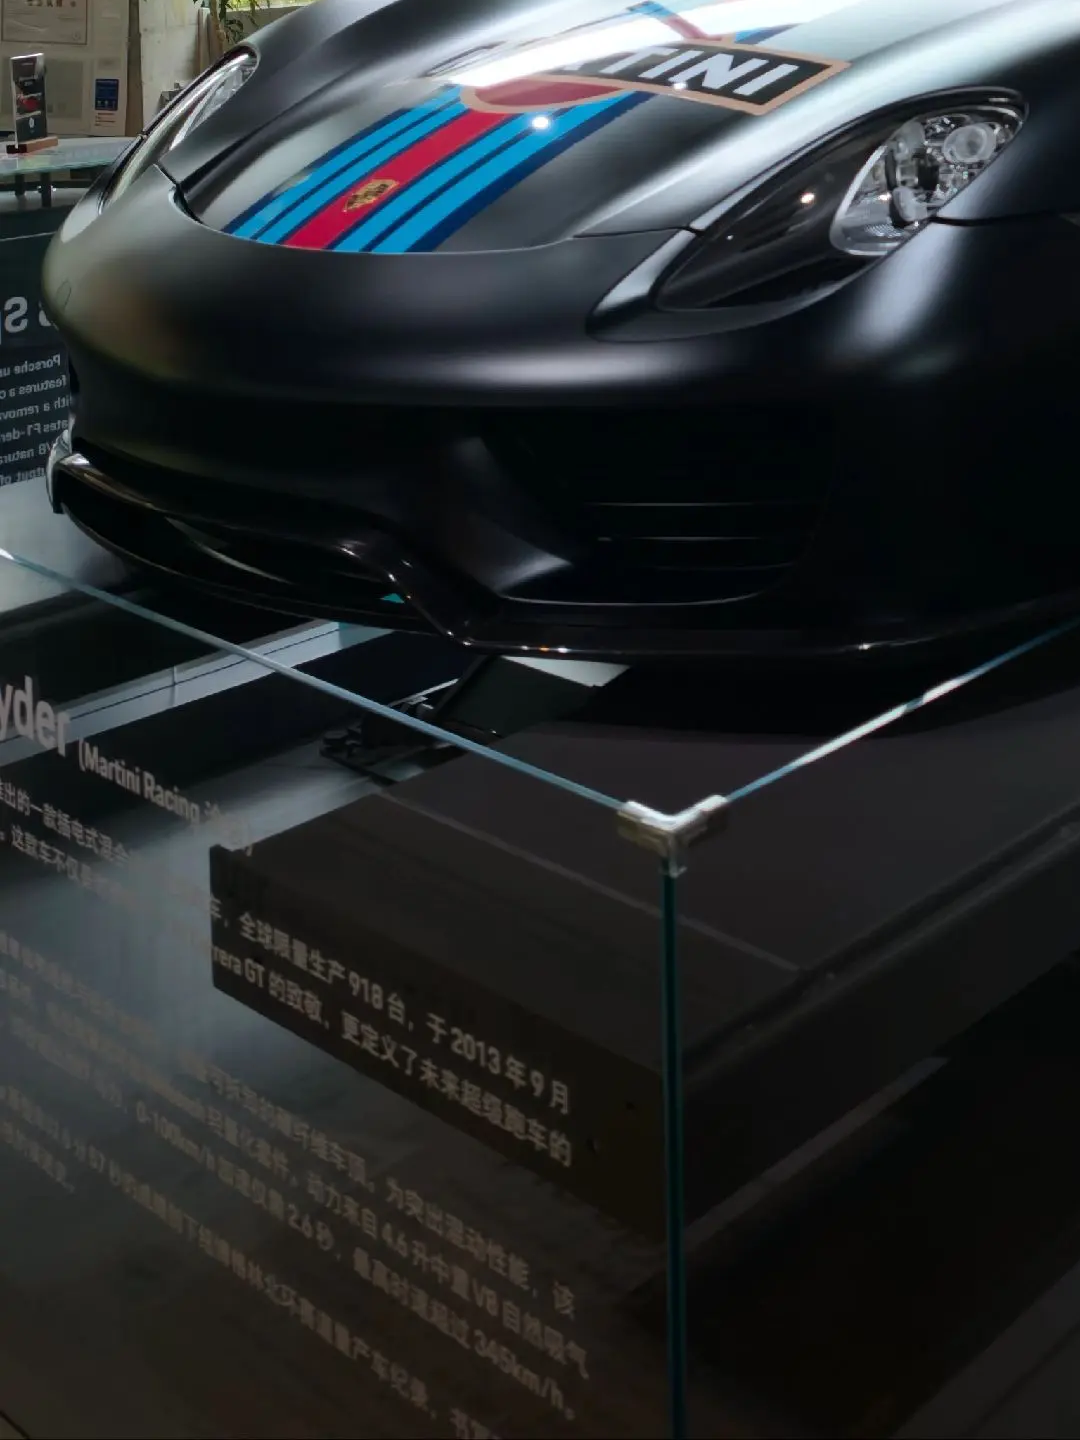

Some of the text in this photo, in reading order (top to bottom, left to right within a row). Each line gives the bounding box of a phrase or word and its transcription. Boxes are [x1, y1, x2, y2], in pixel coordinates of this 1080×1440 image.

[580, 45, 800, 97] TINI
[144, 770, 200, 831] Racing
[244, 958, 267, 988] GT
[348, 970, 383, 1011] 918
[450, 1026, 502, 1076] 2013
